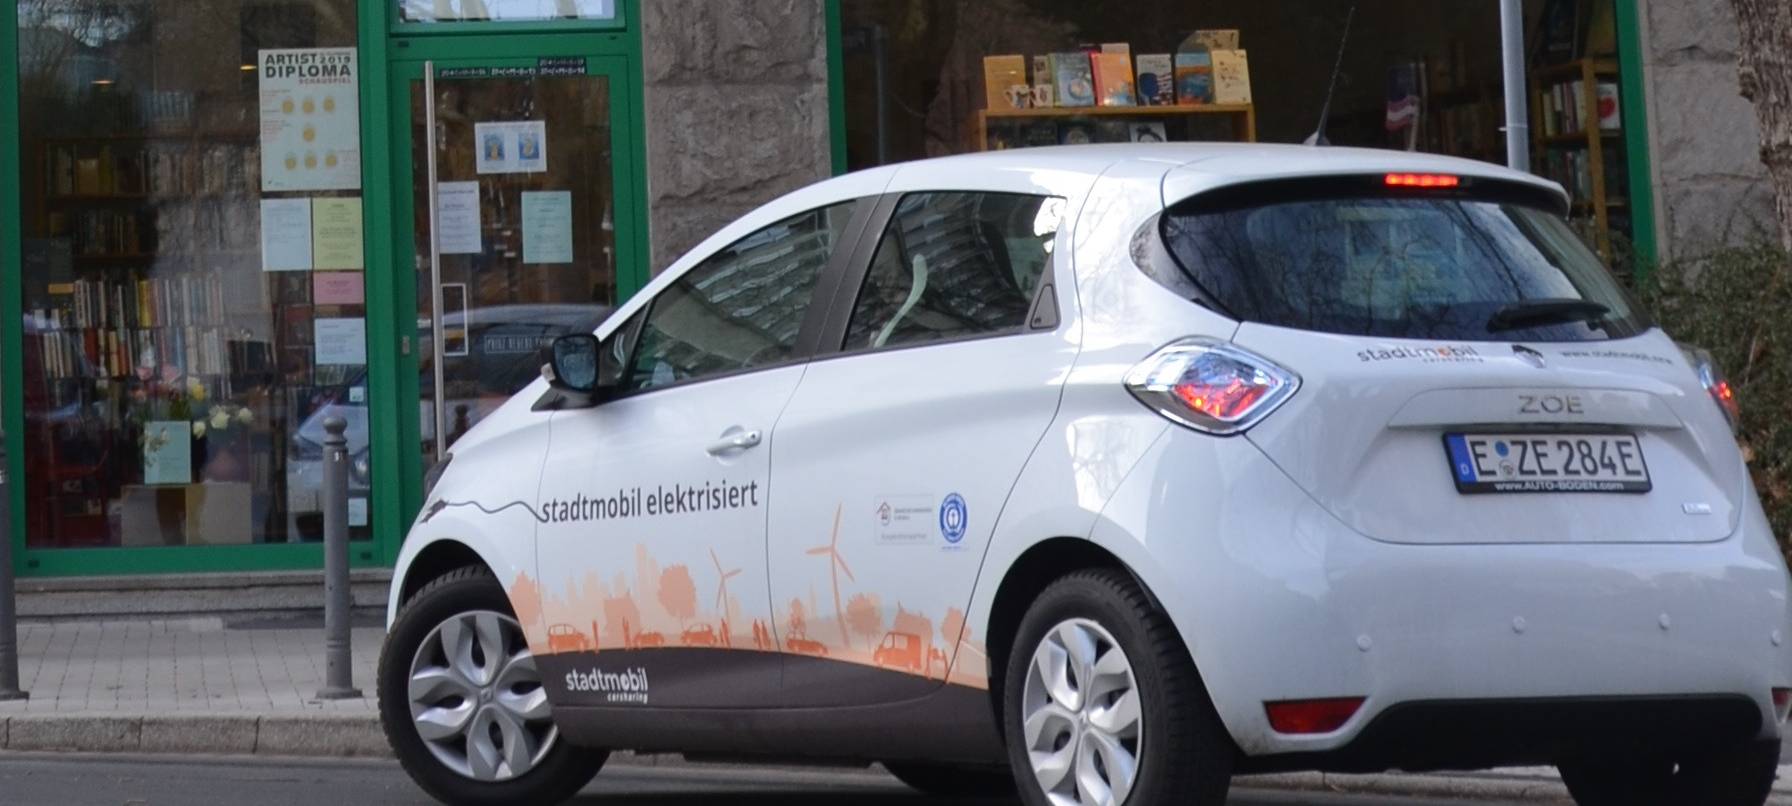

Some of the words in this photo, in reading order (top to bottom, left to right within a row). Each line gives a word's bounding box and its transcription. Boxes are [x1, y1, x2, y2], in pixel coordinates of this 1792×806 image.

[265, 53, 317, 66] ARTIST
[320, 55, 351, 65] 2019
[265, 64, 351, 78] DIPLOMA
[1357, 345, 1479, 361] stadtmobil
[1518, 395, 1584, 415] ZOE
[1469, 440, 1497, 477] E
[1510, 440, 1558, 476] ZE
[541, 487, 642, 523] stadtmobil
[646, 479, 759, 516] elektrisiert
[565, 667, 648, 691] stadtmobil
